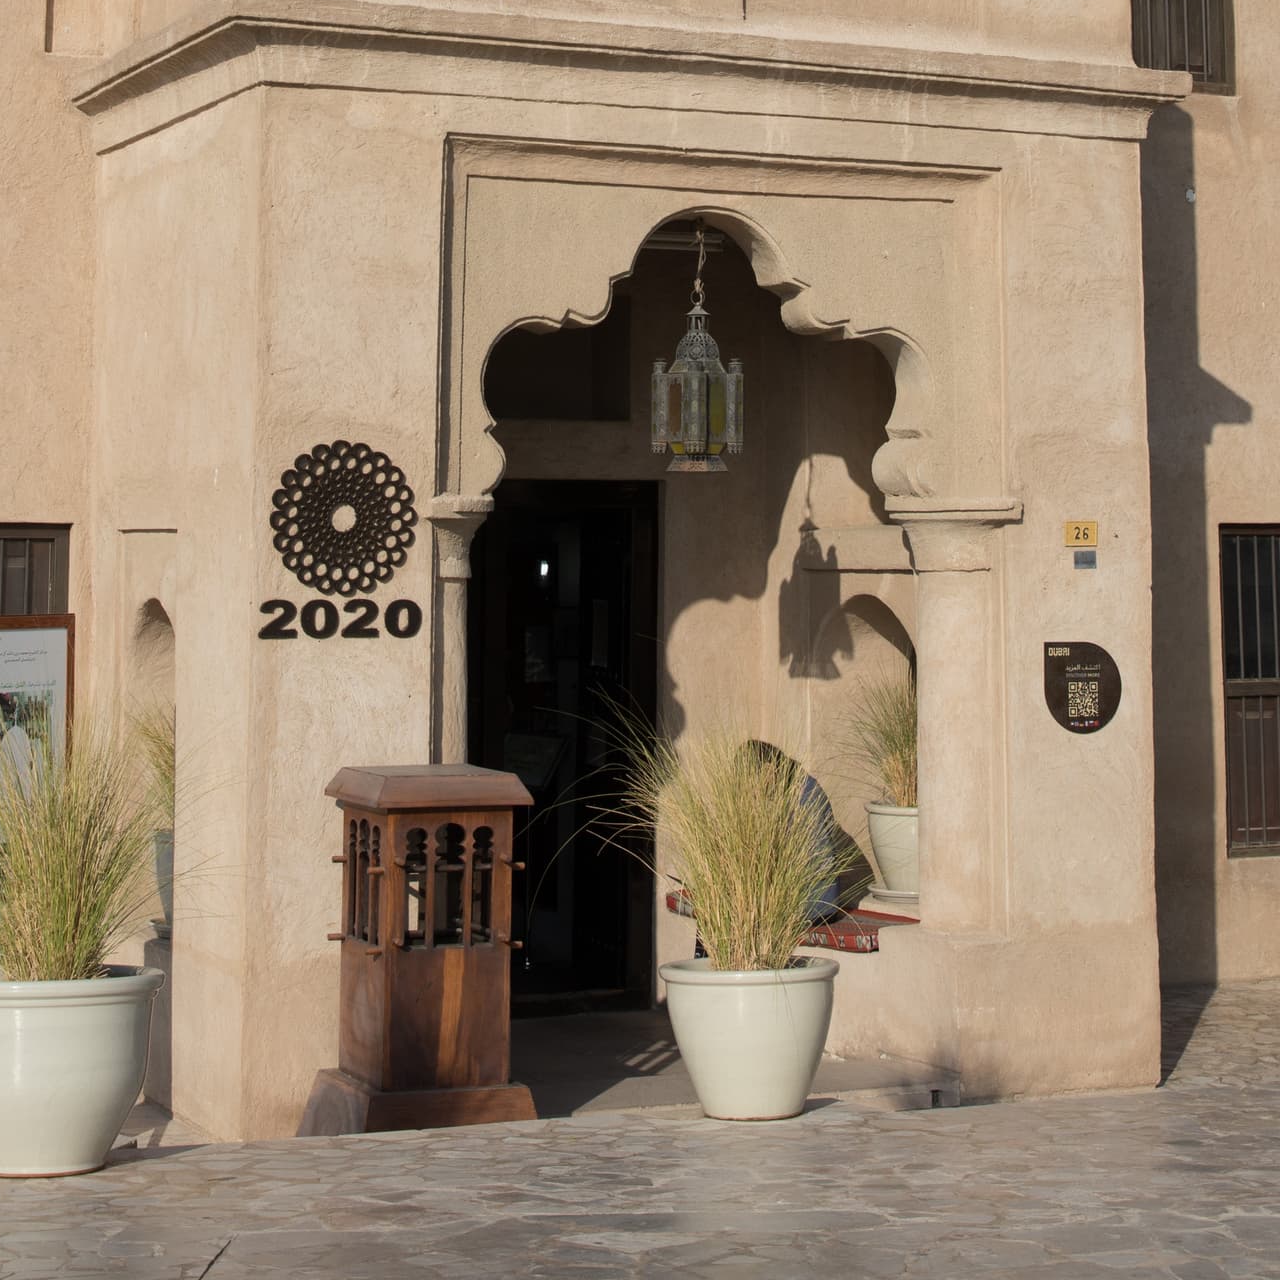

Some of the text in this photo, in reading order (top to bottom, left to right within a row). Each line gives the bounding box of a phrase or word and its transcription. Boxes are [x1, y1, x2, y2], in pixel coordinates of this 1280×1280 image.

[1074, 526, 1089, 540] 26
[257, 598, 423, 640] 2020
[1048, 647, 1070, 657] DUBAI
